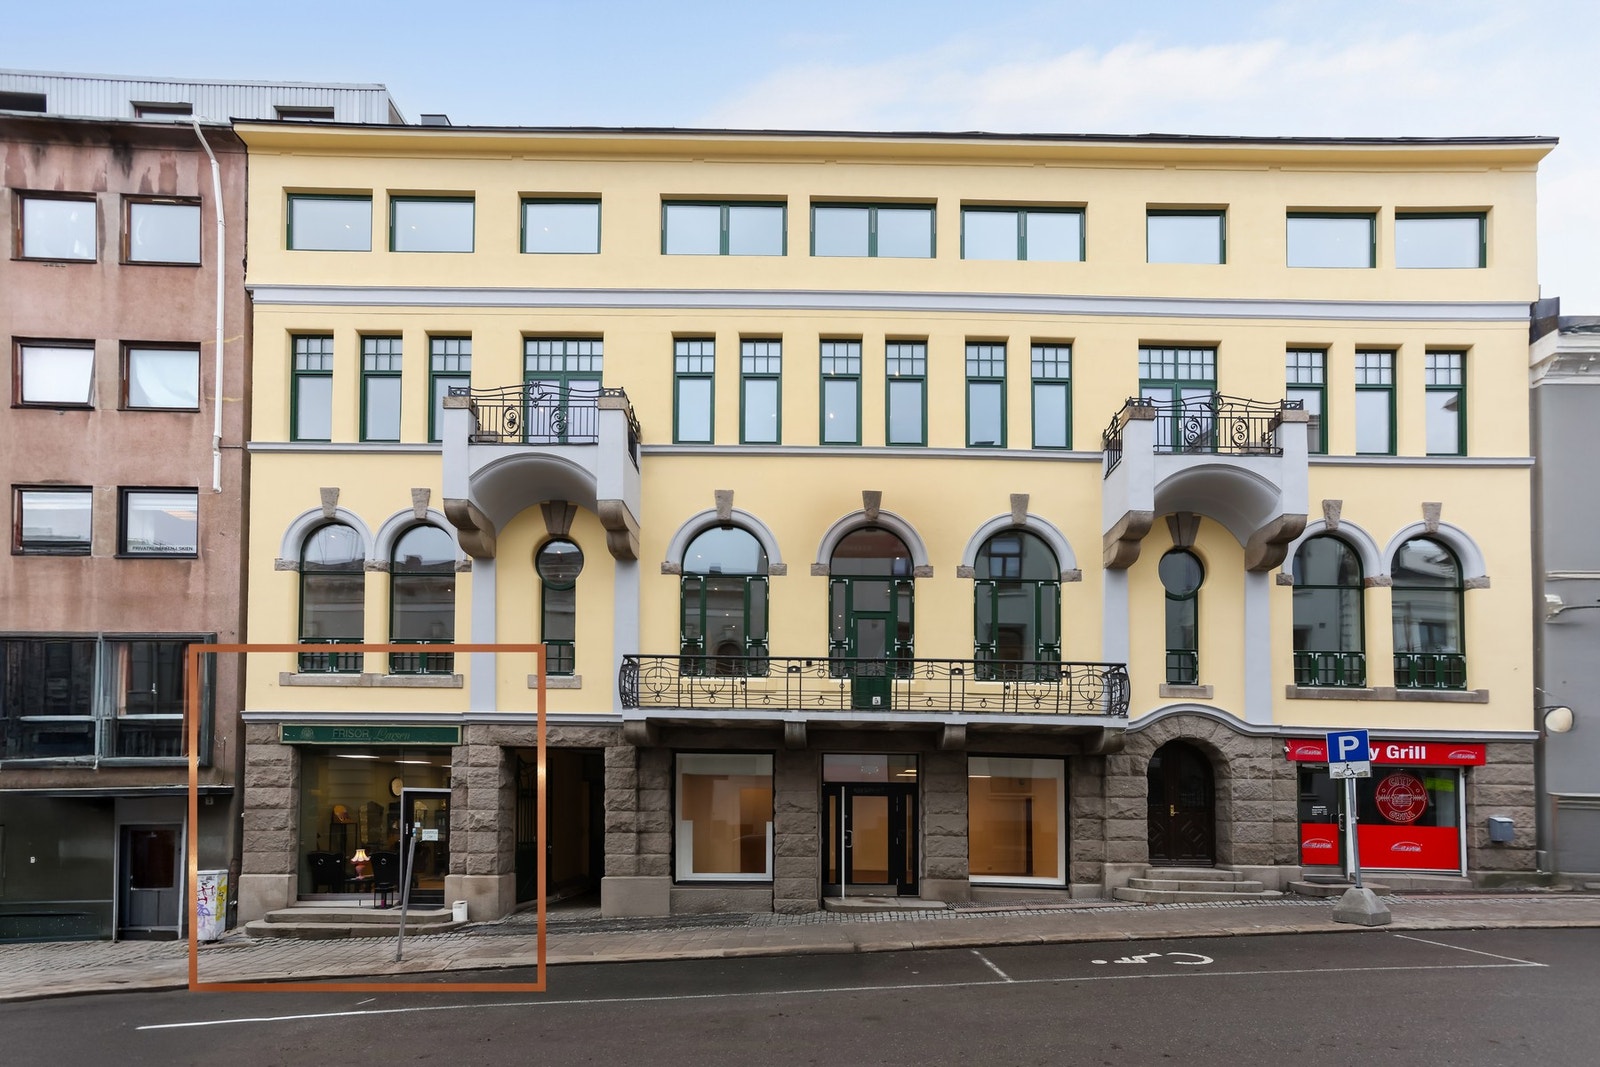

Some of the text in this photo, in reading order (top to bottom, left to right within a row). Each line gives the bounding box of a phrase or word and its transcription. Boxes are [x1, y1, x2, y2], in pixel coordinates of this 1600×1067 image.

[1338, 736, 1360, 760] P
[1386, 745, 1426, 760] Grill
[1388, 776, 1414, 786] CITY
[1388, 810, 1416, 820] GRILL
